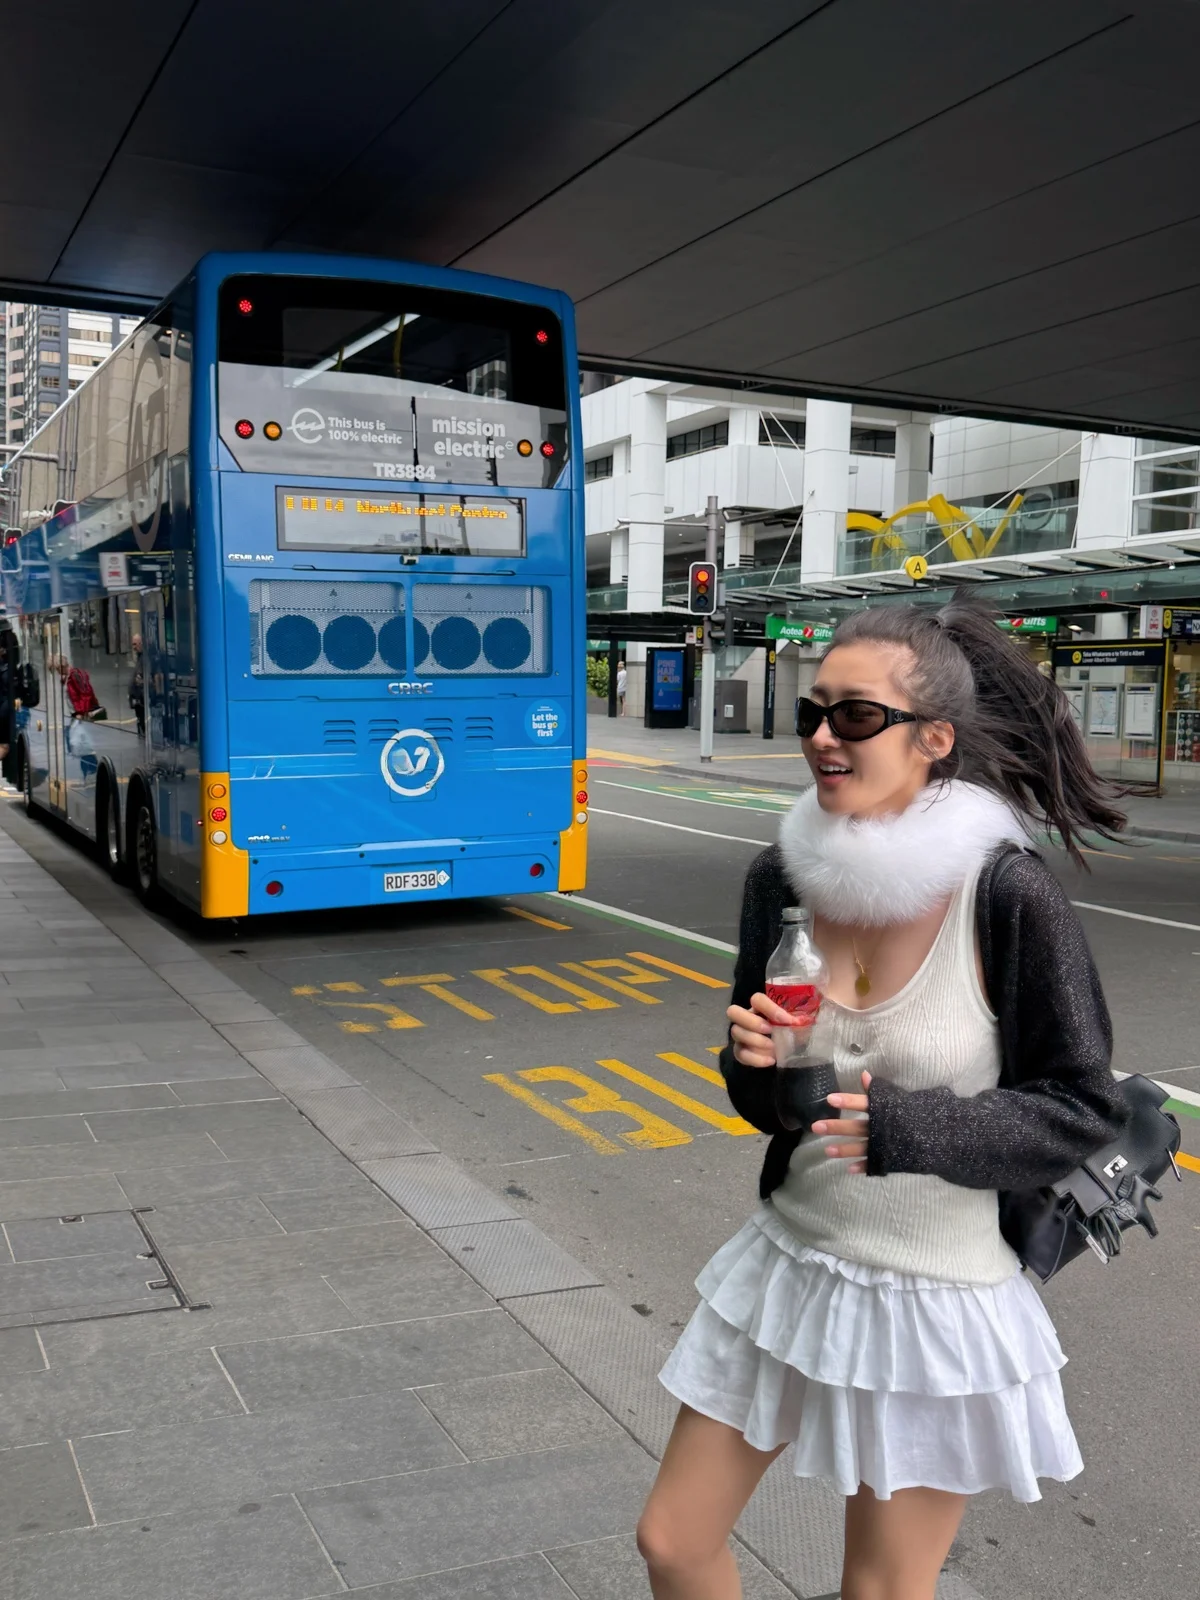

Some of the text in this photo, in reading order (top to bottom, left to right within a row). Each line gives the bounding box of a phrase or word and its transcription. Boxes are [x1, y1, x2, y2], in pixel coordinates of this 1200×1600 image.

[328, 416, 386, 431] This bus is
[432, 416, 506, 437] mission
[328, 430, 402, 445] 100% electric
[434, 438, 505, 459] electric
[373, 462, 436, 480] TR3884
[228, 553, 274, 562] GEMILANG
[913, 561, 922, 573] A
[780, 626, 833, 637] Aotea Gifts
[388, 682, 434, 695] CRRC
[532, 712, 558, 721] Let the
[532, 721, 558, 730] bus go
[537, 729, 553, 737] first
[386, 873, 436, 890] RDF330
[291, 958, 671, 1033] STOP
[482, 1046, 760, 1156] BU
